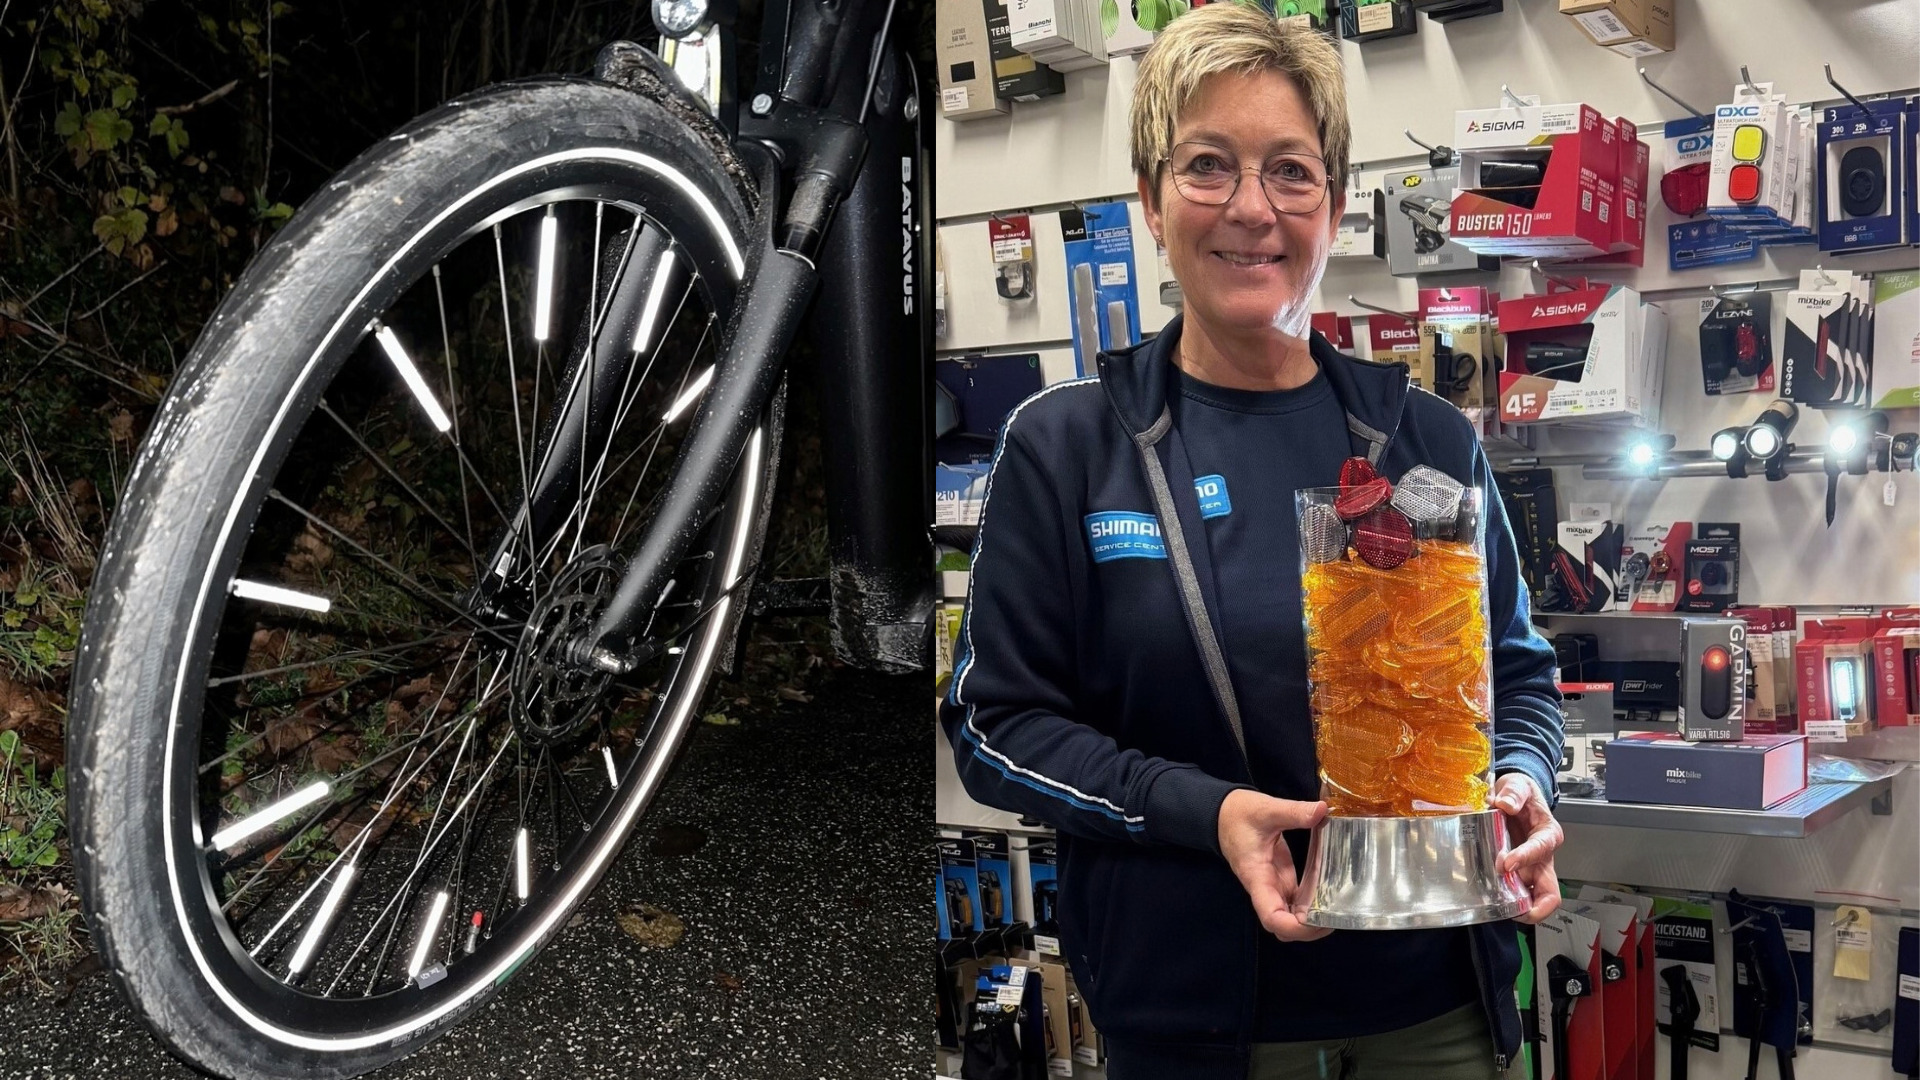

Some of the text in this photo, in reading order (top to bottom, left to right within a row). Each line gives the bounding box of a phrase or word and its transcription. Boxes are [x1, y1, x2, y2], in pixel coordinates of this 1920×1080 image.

[1717, 106, 1759, 117] OXC
[1481, 120, 1525, 132] SIGMA
[1457, 215, 1504, 231] BUSTER
[1506, 213, 1532, 236] 150
[902, 157, 913, 316] BATAVUS
[1701, 300, 1714, 308] 200
[1797, 297, 1832, 306] mixbike
[1427, 305, 1472, 313] Blackburn
[1546, 303, 1587, 316] SIGMA
[1716, 309, 1753, 319] LEZYNE
[1506, 393, 1536, 416] 45
[1095, 542, 1132, 553] SERVICE
[1689, 730, 1731, 739] VARIA RTL516
[1655, 923, 1707, 939] KICKSTAND
